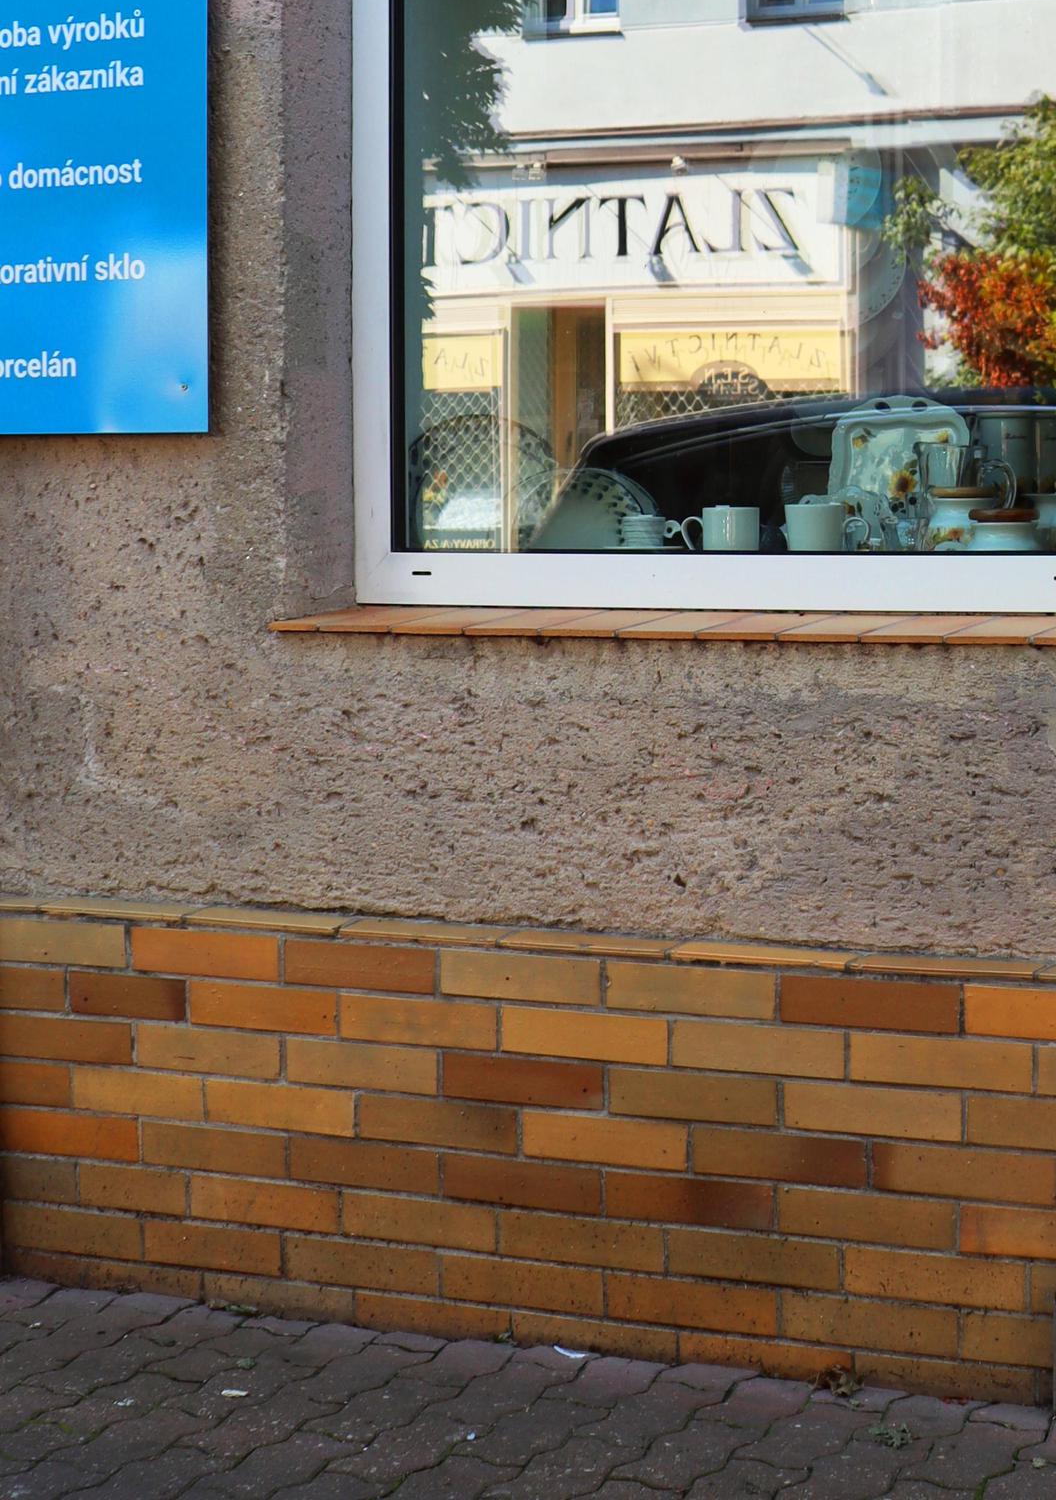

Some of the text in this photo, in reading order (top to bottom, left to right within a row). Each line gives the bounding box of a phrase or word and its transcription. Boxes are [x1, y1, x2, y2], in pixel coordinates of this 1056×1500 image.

[48, 10, 146, 49] výrobků
[24, 60, 144, 95] zákazníka
[9, 158, 142, 190] domácnost
[94, 253, 146, 281] sklo
